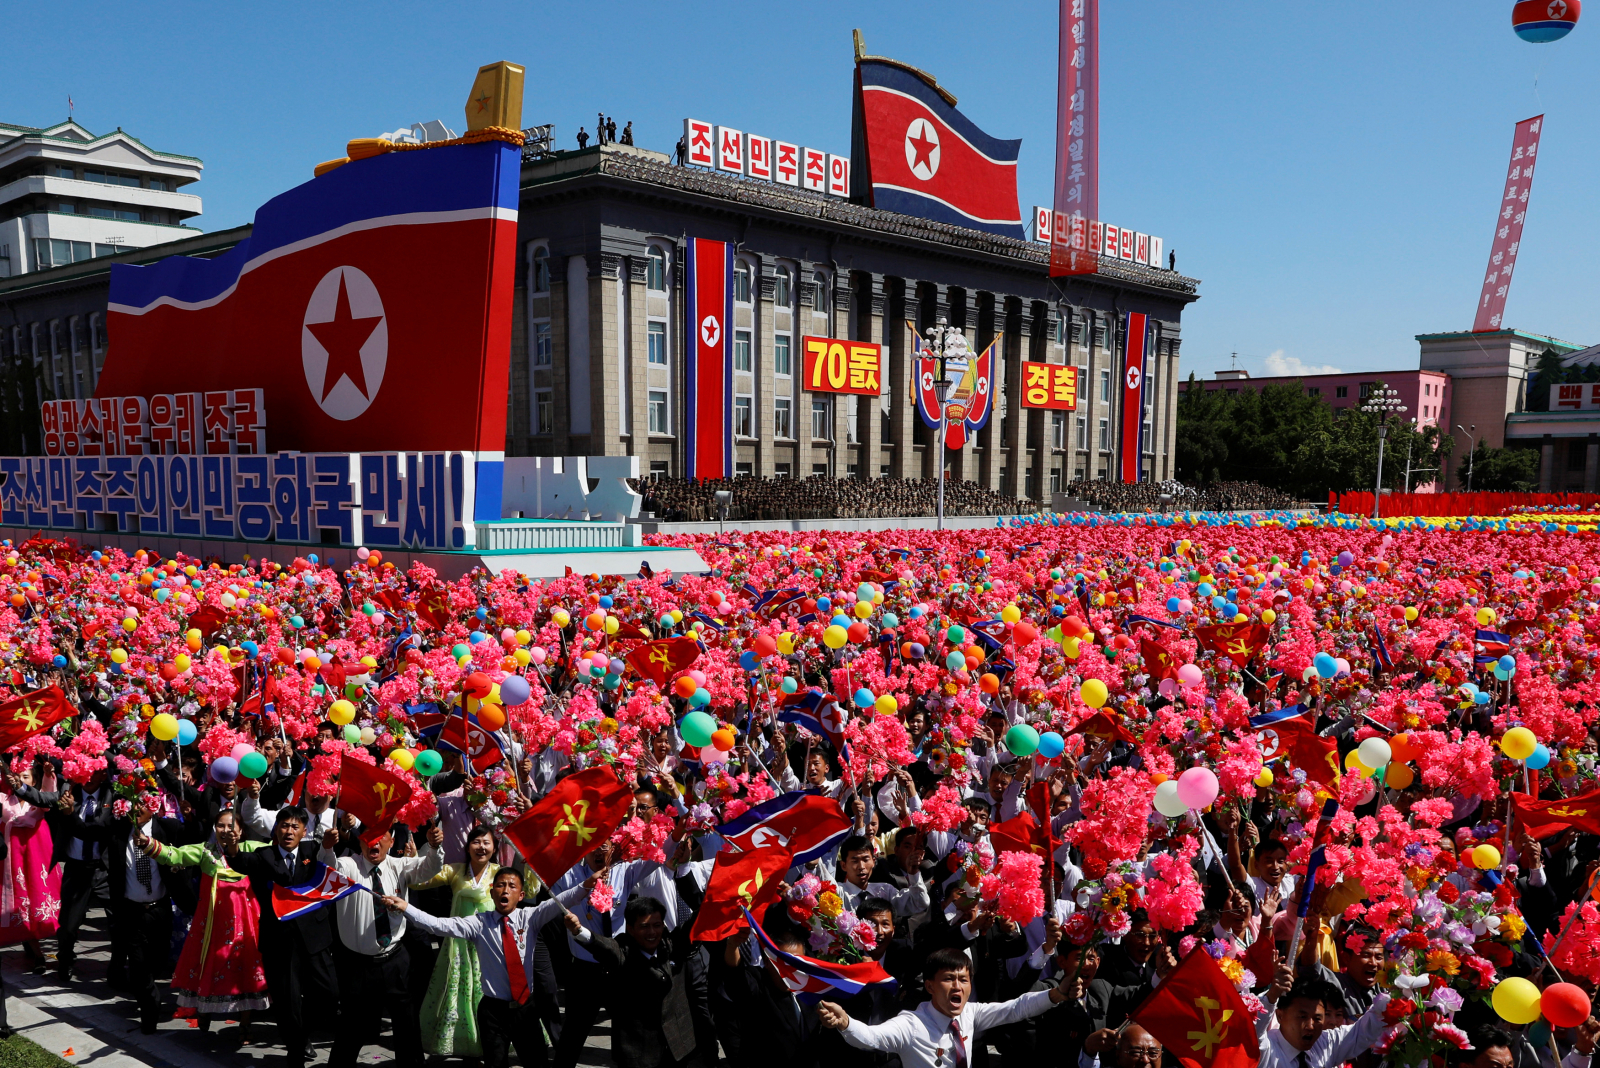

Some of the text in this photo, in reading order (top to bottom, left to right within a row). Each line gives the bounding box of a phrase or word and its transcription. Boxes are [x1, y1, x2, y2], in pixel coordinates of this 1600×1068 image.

[691, 122, 848, 195] 조선민주주의
[1497, 146, 1524, 240] 조선로동당
[1489, 313, 1502, 327] 당
[1026, 364, 1075, 407] 경축
[41, 388, 260, 457] 영광스러운 우리 조국
